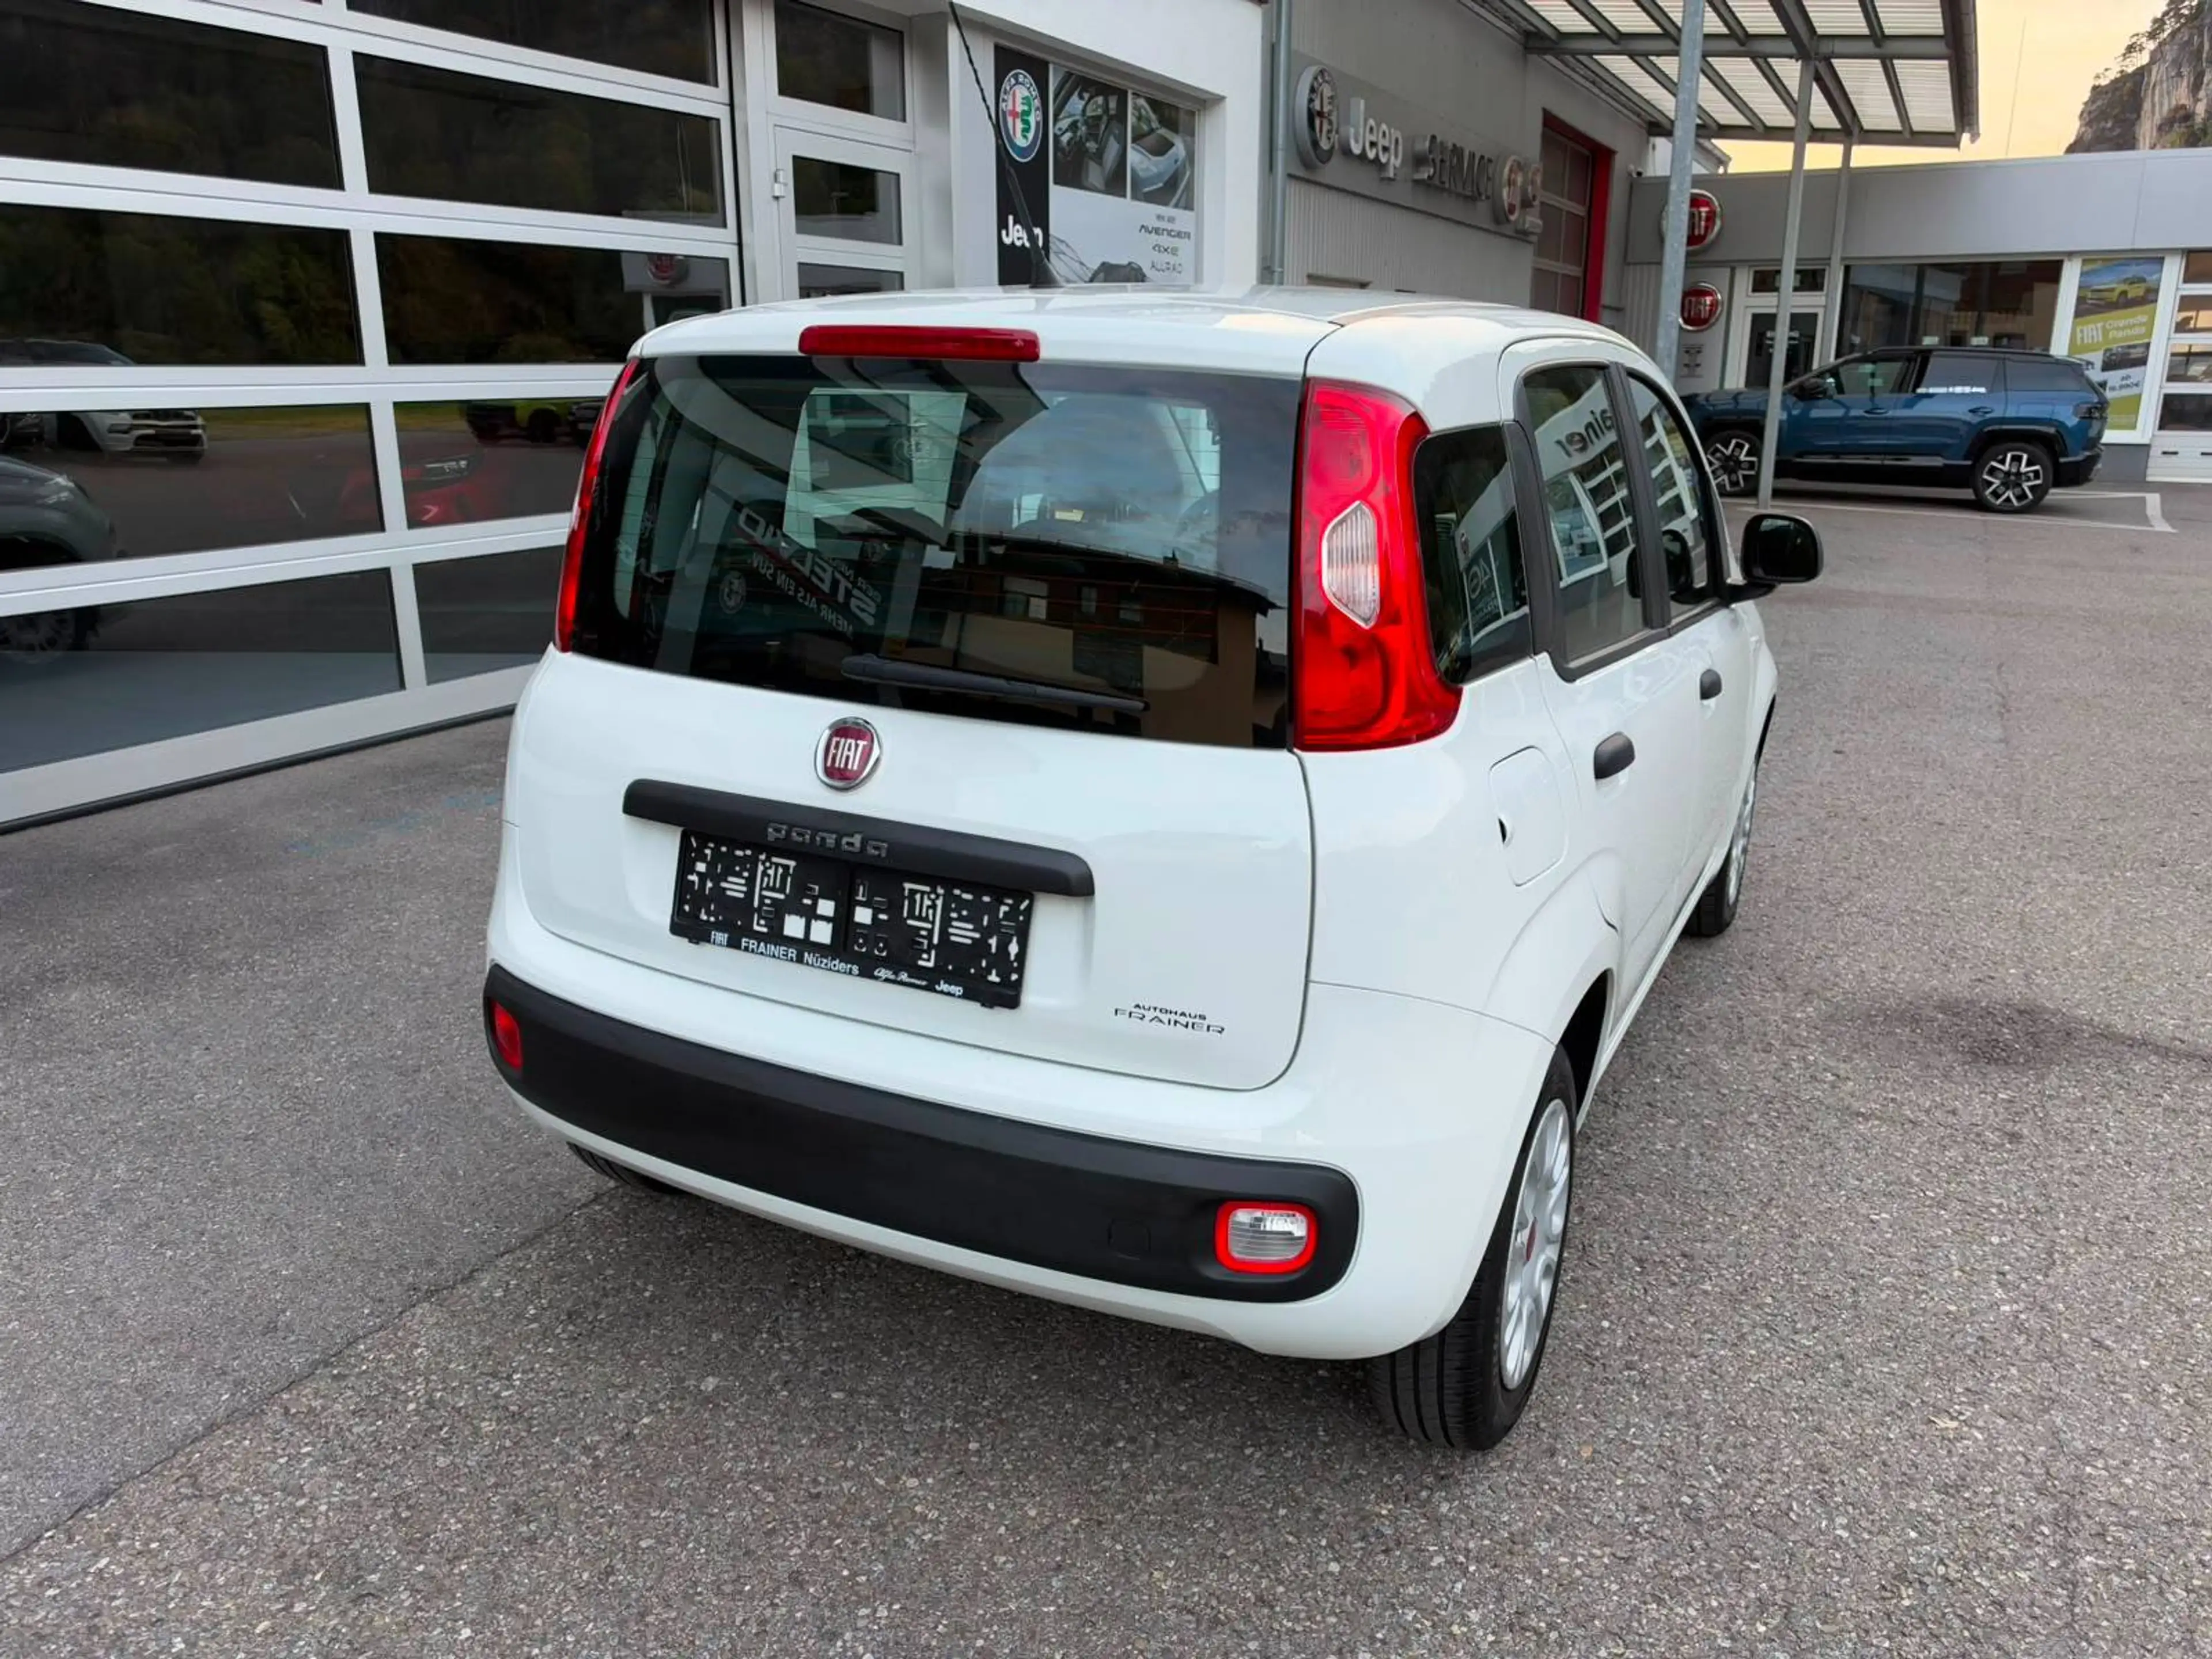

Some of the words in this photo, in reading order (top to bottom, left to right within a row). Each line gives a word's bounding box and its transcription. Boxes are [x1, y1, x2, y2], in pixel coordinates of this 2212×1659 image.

[1349, 97, 1403, 178] Jeep
[1427, 134, 1494, 200] SERVICE
[2077, 323, 2103, 346] FIAT
[827, 736, 868, 771] FIAT
[767, 823, 888, 857] panda
[710, 930, 728, 945] FIAT
[741, 937, 797, 961] FRAINER
[804, 951, 859, 975] Nüziders
[935, 979, 963, 996] Jeep
[1114, 1007, 1225, 1034] FRAINER
[1133, 1003, 1206, 1021] AUTOHAUS
